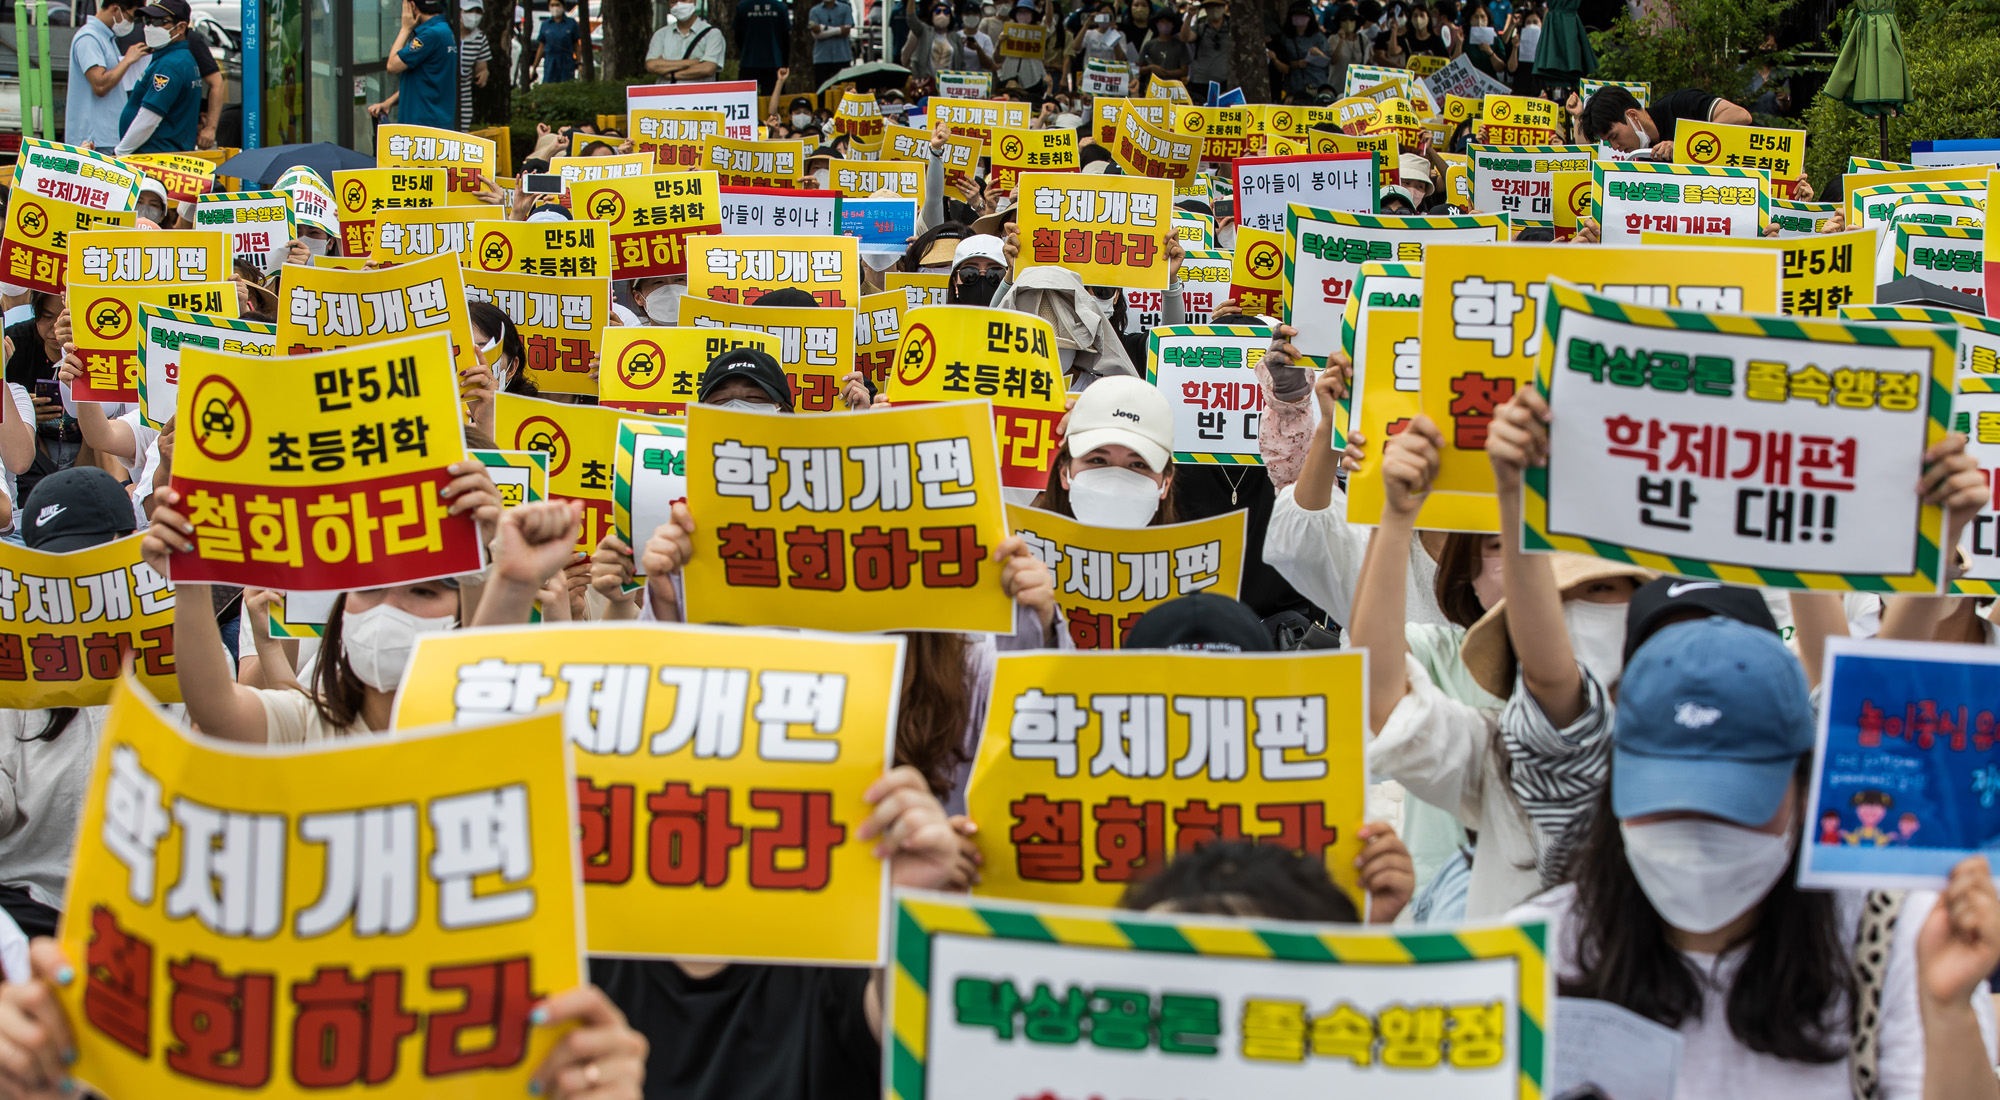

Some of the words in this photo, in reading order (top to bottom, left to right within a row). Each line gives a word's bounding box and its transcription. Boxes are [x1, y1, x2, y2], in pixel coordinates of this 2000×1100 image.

[1368, 86, 1398, 102] 개편
[723, 104, 749, 120] 가고
[935, 104, 998, 126] 학제개편
[1102, 105, 1163, 123] 학편
[1220, 111, 1242, 122] 만5세
[1308, 110, 1333, 122] 만5세
[1527, 101, 1551, 113] 만5세
[248, 112, 256, 130] War
[639, 116, 718, 141] 학제개편
[1206, 124, 1242, 135] 초등취학
[1513, 114, 1551, 126] 초등취학
[389, 134, 484, 163] 학제개편
[1043, 133, 1071, 148] 만5세
[1125, 112, 1192, 161] 학제개편
[1201, 139, 1245, 158] 회하라
[1357, 139, 1388, 153] 만5세
[1488, 127, 1551, 145] 철회하라
[1750, 133, 1791, 153] 만5세
[638, 142, 703, 165] 철회하
[712, 145, 795, 174] 학제개편
[1027, 151, 1073, 166] 초등취학
[1120, 136, 1189, 179] 철회하라
[1478, 157, 1533, 173] 탁상공론
[1534, 159, 1588, 173] 졸속행정
[30, 153, 79, 175] 탁상공론
[80, 163, 131, 188] 졸속행정
[391, 174, 433, 192] 만5세
[838, 168, 918, 194] 학제개편
[1241, 173, 1300, 195] 유아들이
[1311, 170, 1358, 191] 봉이냐
[37, 177, 110, 209] 학제개편
[293, 190, 327, 210] 개편
[654, 178, 702, 199] 만5세
[1491, 178, 1553, 197] 학제개
[1609, 182, 1680, 203] 탁상공론
[1683, 184, 1756, 206] 졸속행정
[197, 208, 234, 225] 탁상공론
[236, 206, 285, 223] 졸속행정
[296, 202, 323, 218] 대!!
[633, 202, 705, 227] 초등취학
[721, 204, 764, 226] 아들이
[772, 206, 819, 228] 봉이냐
[827, 210, 832, 227] !
[1034, 187, 1158, 227] 학제개편
[1501, 196, 1521, 214] 반
[233, 231, 271, 253] 개편
[380, 222, 472, 255] 학제개
[545, 228, 595, 250] 만5세
[1177, 226, 1203, 241] 행정
[1032, 228, 1158, 268] 철회하라
[1303, 232, 1393, 264] 탁상공론
[9, 246, 68, 286] 철회
[82, 246, 207, 282] 학제개편
[520, 256, 597, 277] 초등취학
[705, 248, 843, 283] 학제개편
[1177, 265, 1231, 283] 졸속행정
[1783, 244, 1852, 279] 만5세
[168, 290, 223, 313] 만5세
[290, 277, 450, 337] 학제개편
[987, 321, 1050, 360] 만5세
[517, 334, 597, 373] 하라
[727, 361, 756, 370] grin
[1163, 346, 1243, 368] 탁상공론
[314, 356, 420, 413] 만5세
[942, 361, 1054, 402] 초등취학
[1567, 338, 1735, 397] 탁상공론
[1745, 358, 1922, 412] 졸속행정
[1182, 380, 1264, 411] 학제개
[1112, 408, 1140, 423] Jeep
[1197, 412, 1226, 440] 반
[268, 416, 430, 473] 초등취학
[1604, 414, 1858, 491] 학제개편
[712, 436, 978, 512] 학제개편
[40, 503, 60, 518] NIKE
[1638, 476, 1698, 532] 반
[1735, 487, 1837, 543] 대!!
[186, 480, 450, 568] 철회하라
[717, 523, 987, 592] 철회하라
[452, 659, 848, 763] 학제개편
[1009, 688, 1328, 781] 학제개편
[1972, 711, 2000, 751] 유
[104, 745, 536, 940] 학제개편
[575, 778, 847, 892] 회하라
[84, 905, 548, 1090] 철회하라
[952, 975, 1220, 1057] 탁상공론
[1238, 996, 1505, 1069] 졸속행정
